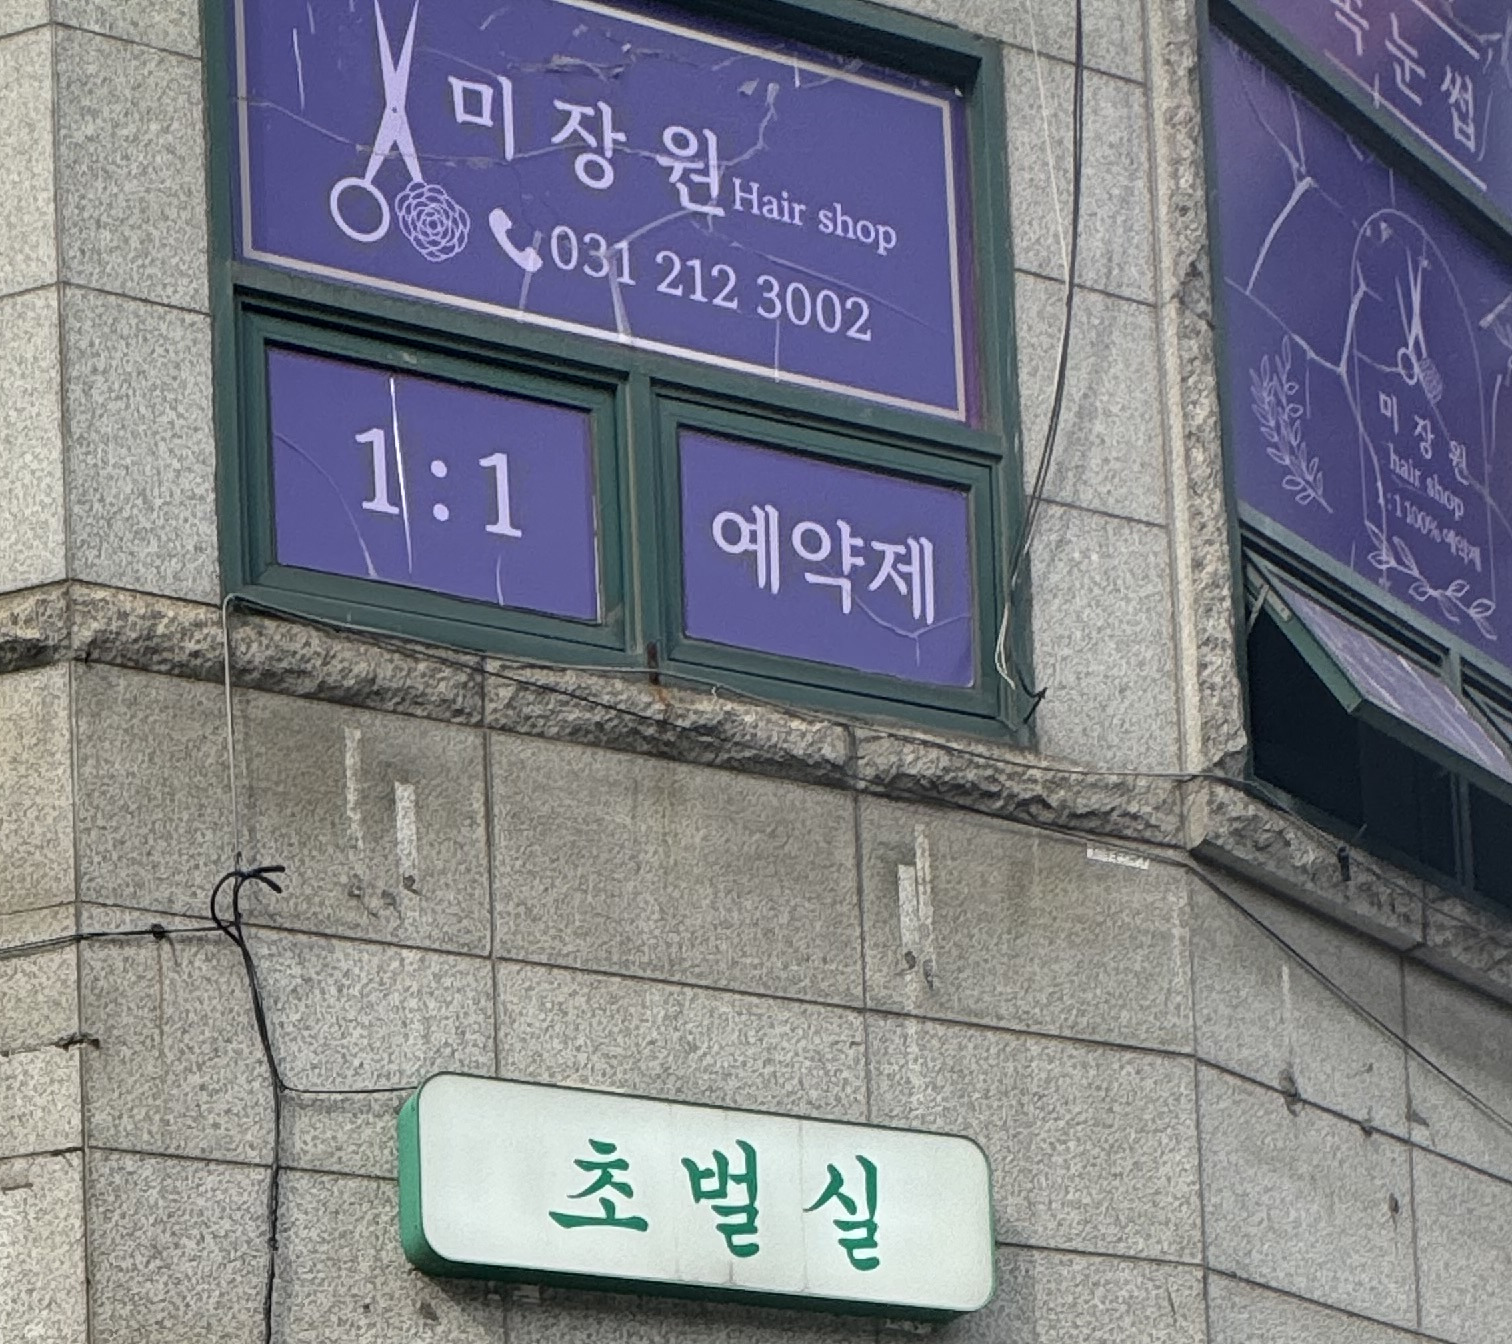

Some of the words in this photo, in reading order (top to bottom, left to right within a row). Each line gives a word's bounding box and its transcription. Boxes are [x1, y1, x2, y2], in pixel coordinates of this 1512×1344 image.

[448, 74, 726, 218] 미장원
[734, 178, 807, 227] Hair
[817, 201, 898, 256] shop
[552, 224, 635, 287] 031
[656, 251, 739, 311] 212
[756, 275, 873, 343] 3002
[354, 427, 523, 539] 1:1
[711, 503, 936, 626] 예약제
[548, 1138, 881, 1272] 초벌실
